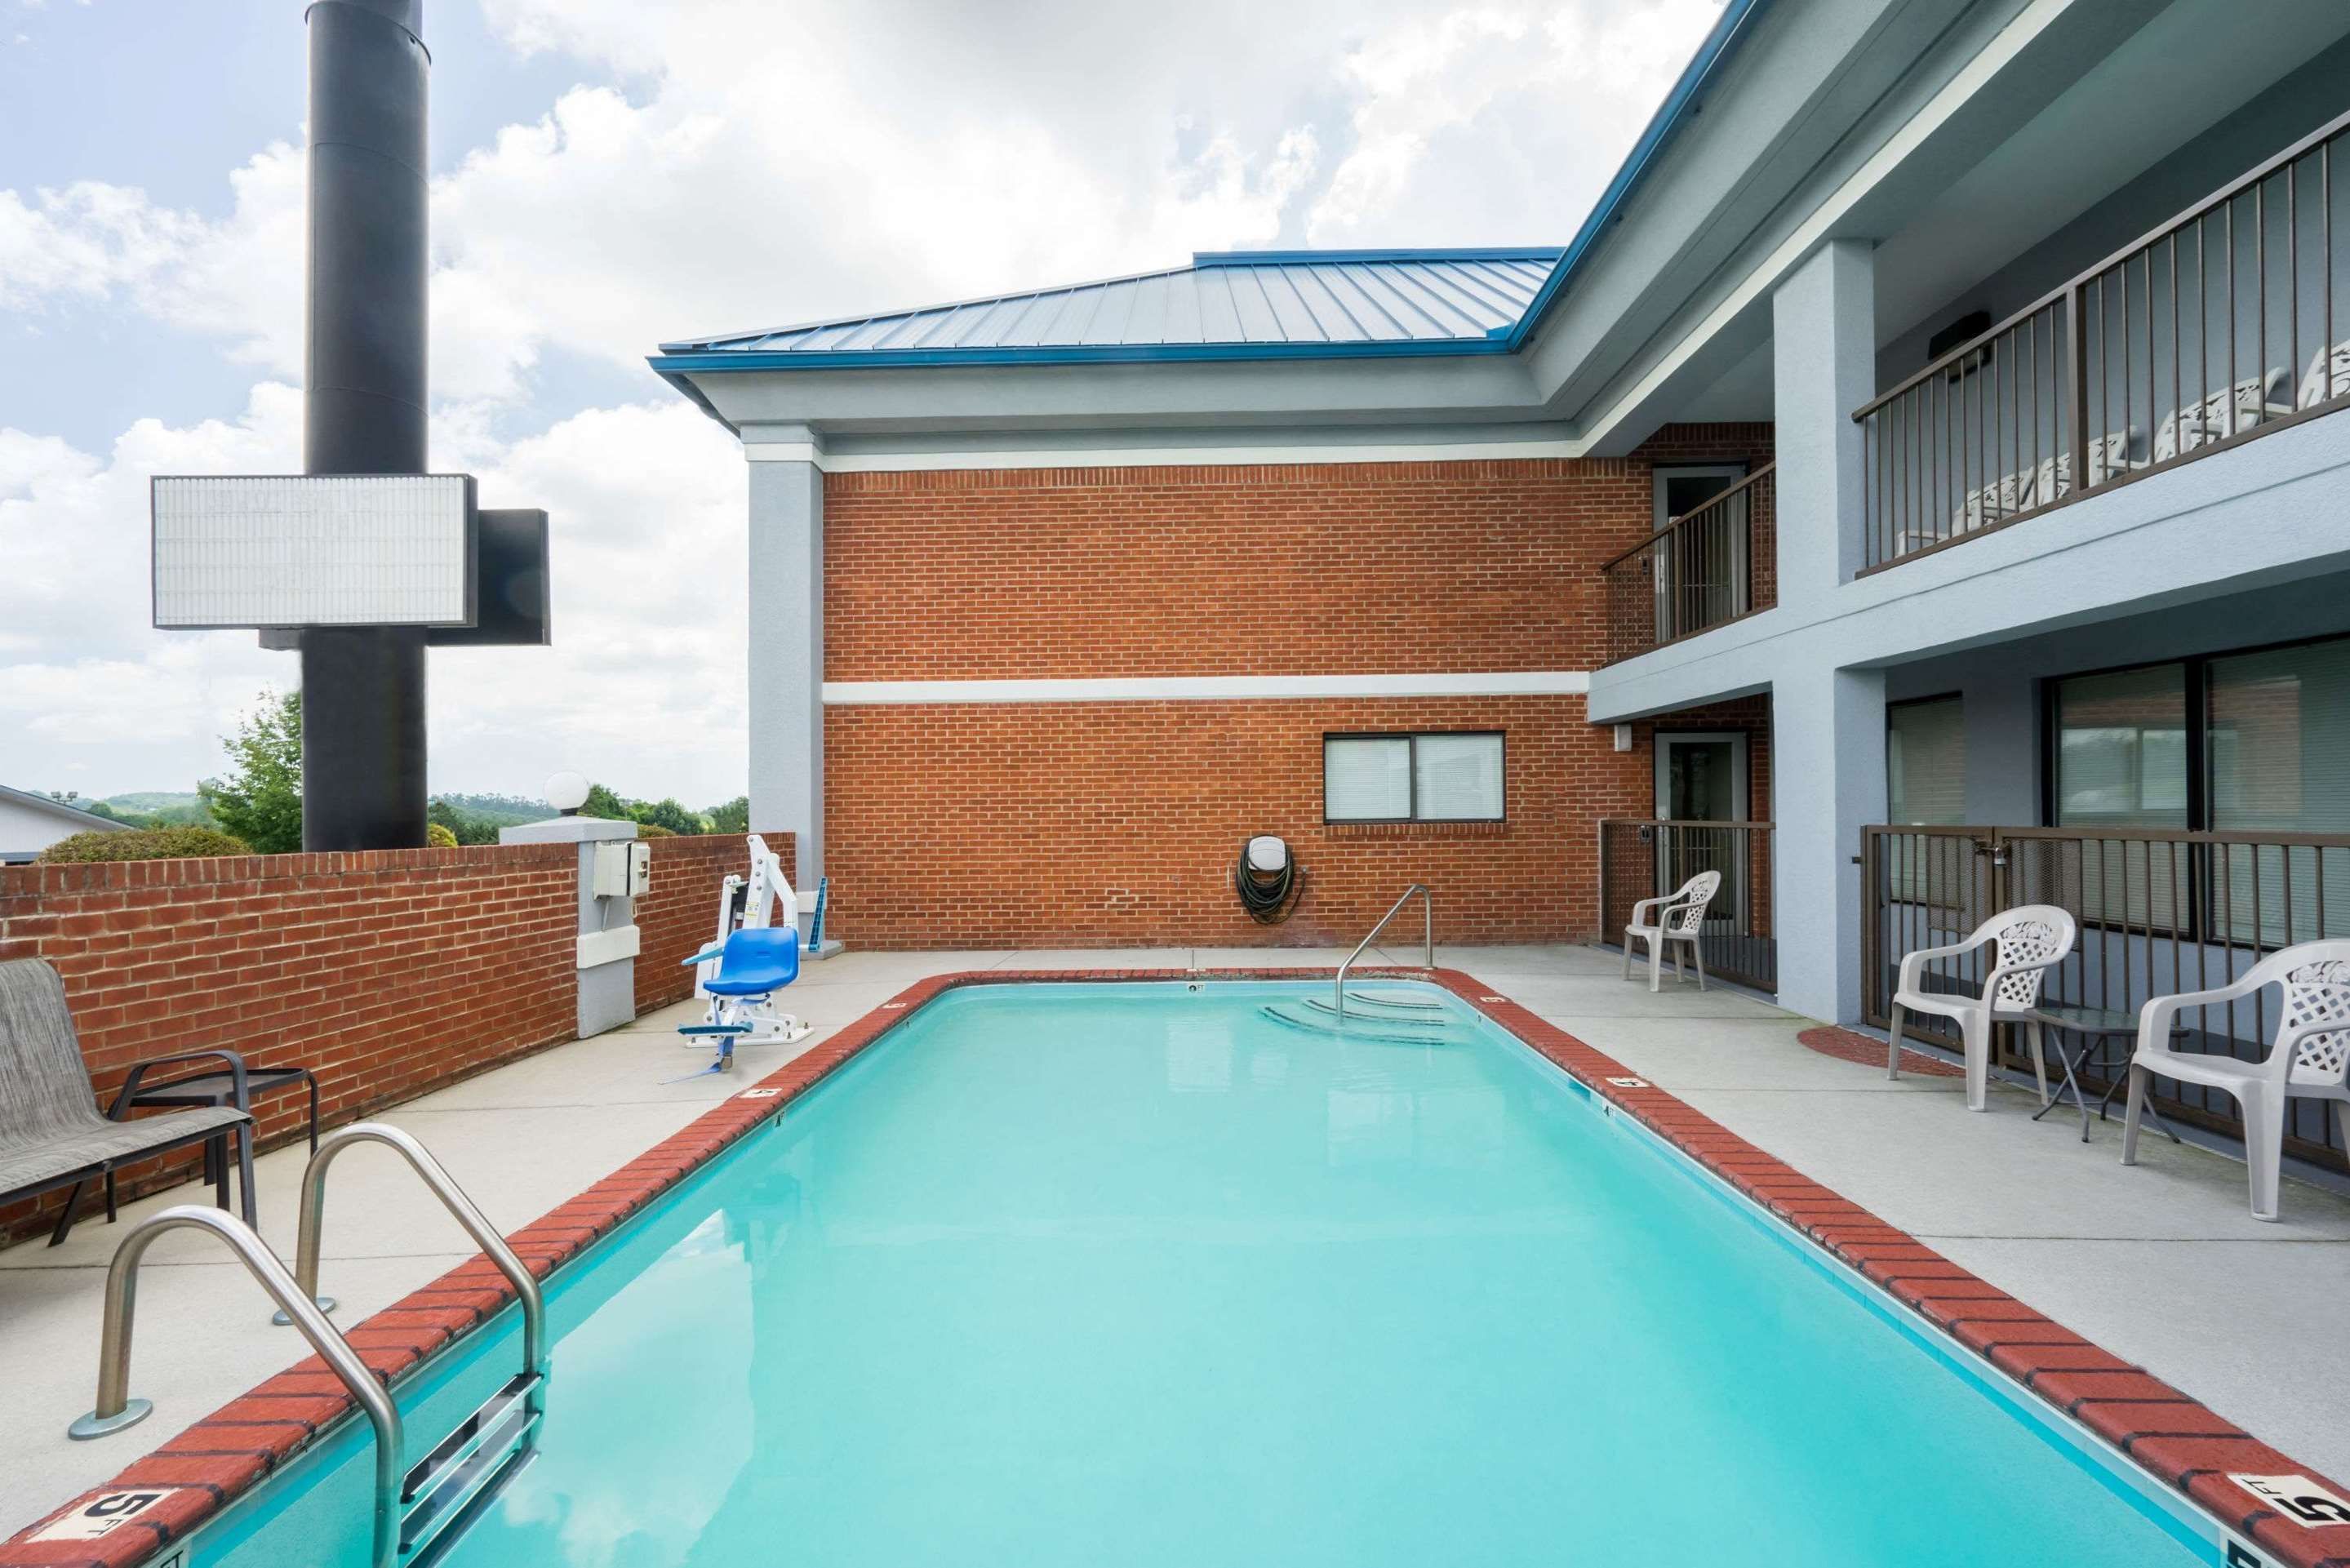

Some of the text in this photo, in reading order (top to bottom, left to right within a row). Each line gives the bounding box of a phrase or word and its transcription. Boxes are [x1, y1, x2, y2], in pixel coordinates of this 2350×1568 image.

[84, 1494, 162, 1535] 5 FT
[2241, 1478, 2350, 1522] 5 FT
